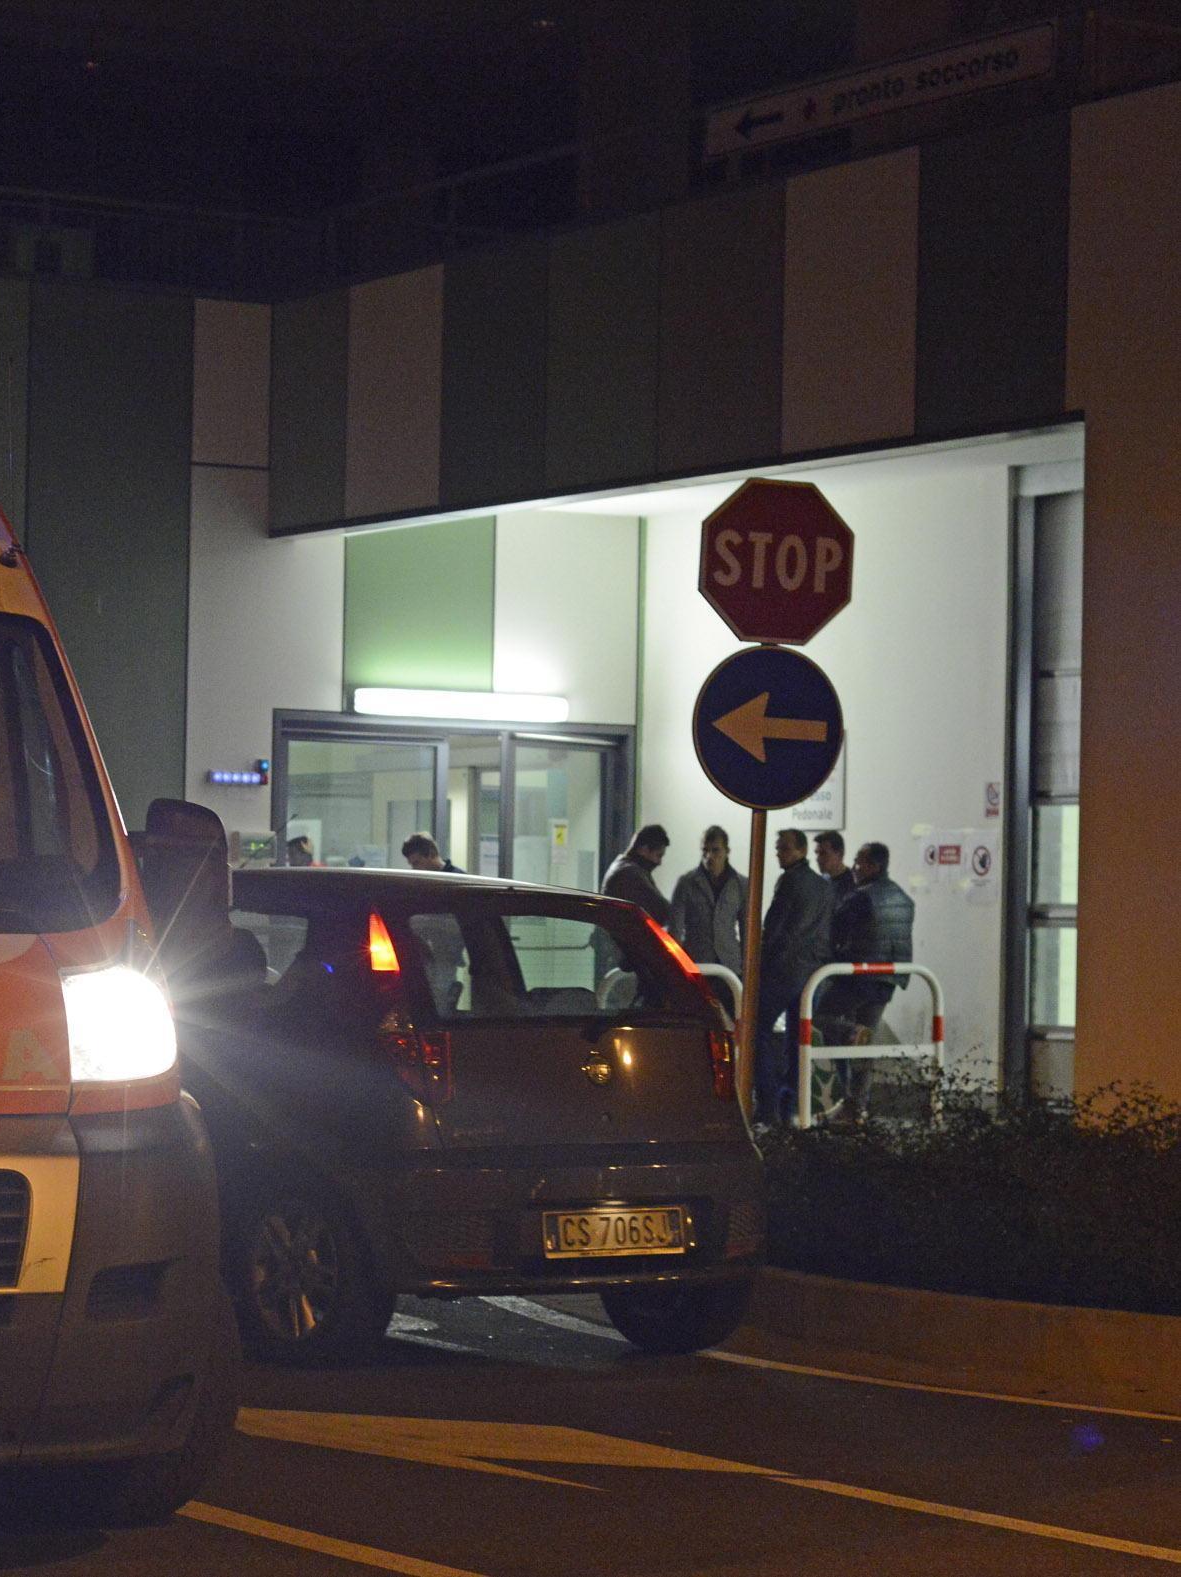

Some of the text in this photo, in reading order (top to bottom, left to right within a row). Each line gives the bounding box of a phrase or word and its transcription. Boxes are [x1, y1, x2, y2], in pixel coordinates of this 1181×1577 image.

[831, 49, 1019, 116] pronto soccorso
[713, 528, 844, 594] STOP
[563, 1214, 669, 1247] CS 706SJ
